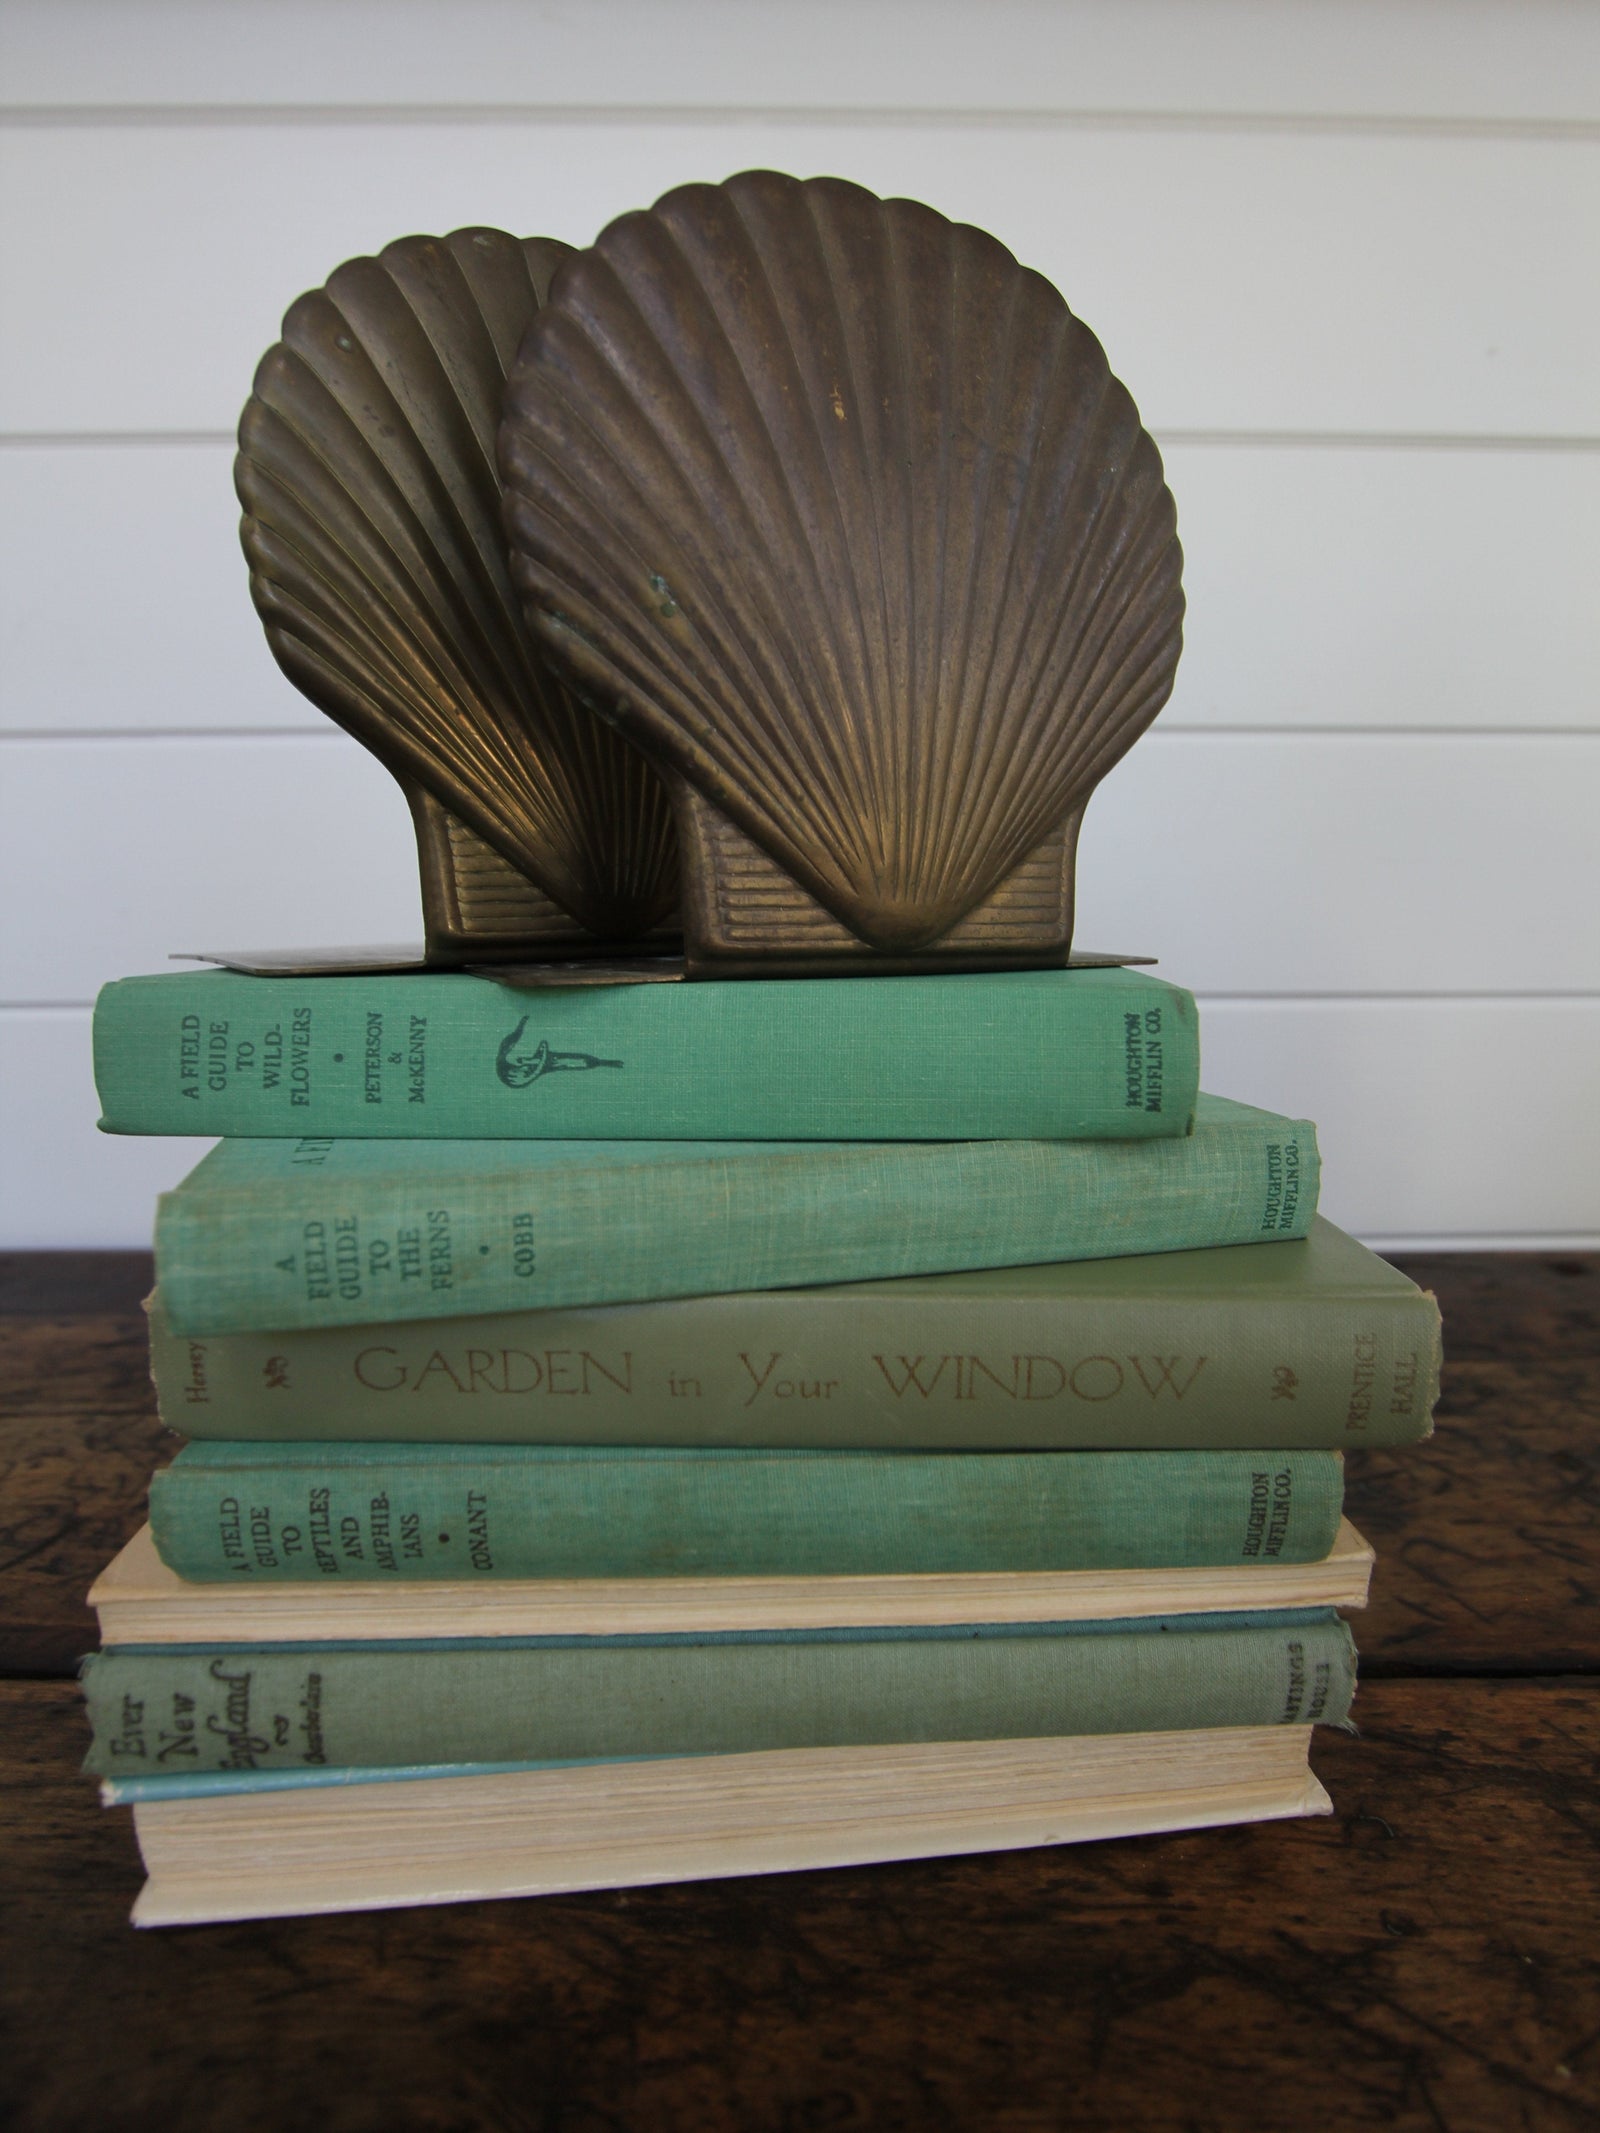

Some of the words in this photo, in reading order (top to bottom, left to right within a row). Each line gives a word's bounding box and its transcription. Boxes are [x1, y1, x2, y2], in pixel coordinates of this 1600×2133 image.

[181, 1014, 200, 1082] FIELD
[208, 1020, 229, 1091] GUIDE
[236, 1041, 255, 1071] TO
[263, 1023, 283, 1089] WILD-
[291, 1008, 312, 1106] FLOWERS
[365, 1012, 383, 1104] PETERSON
[388, 1052, 402, 1064] &
[408, 1015, 427, 1104] McKENNY
[1124, 1012, 1143, 1108] HOUGHTON
[1145, 1041, 1163, 1113] MIFFLIN
[182, 1086, 200, 1100] A
[1283, 1139, 1298, 1168] CO.
[1261, 1144, 1282, 1231] HOUGHTON
[1278, 1168, 1298, 1230] MIFFLIN
[275, 1254, 296, 1274] A
[304, 1221, 330, 1300] FIELD
[335, 1215, 361, 1300] GUIDE
[370, 1239, 390, 1276] TO
[397, 1227, 422, 1281] THE
[427, 1210, 453, 1291] FERNS
[514, 1213, 536, 1278] COBB
[354, 1346, 634, 1397] GARDEN
[668, 1370, 702, 1398] in
[738, 1351, 840, 1407] Your
[871, 1354, 1208, 1401] WINDOW
[1345, 1331, 1377, 1432] PRENTICE
[1391, 1351, 1417, 1415] HALL
[1242, 1472, 1269, 1558] HOUGHTON
[1275, 1467, 1292, 1500] CO.
[220, 1496, 243, 1561] FIELD
[251, 1505, 278, 1568] GUIDE
[281, 1525, 302, 1557] TO
[340, 1516, 365, 1560] AND
[370, 1491, 399, 1572] AMPHIB-
[401, 1513, 423, 1559] IANS
[468, 1490, 493, 1571] CONANT
[1263, 1500, 1291, 1557] MIFFLIN
[232, 1562, 253, 1573] A
[110, 1693, 147, 1759] Ever
[158, 1692, 199, 1764] New
